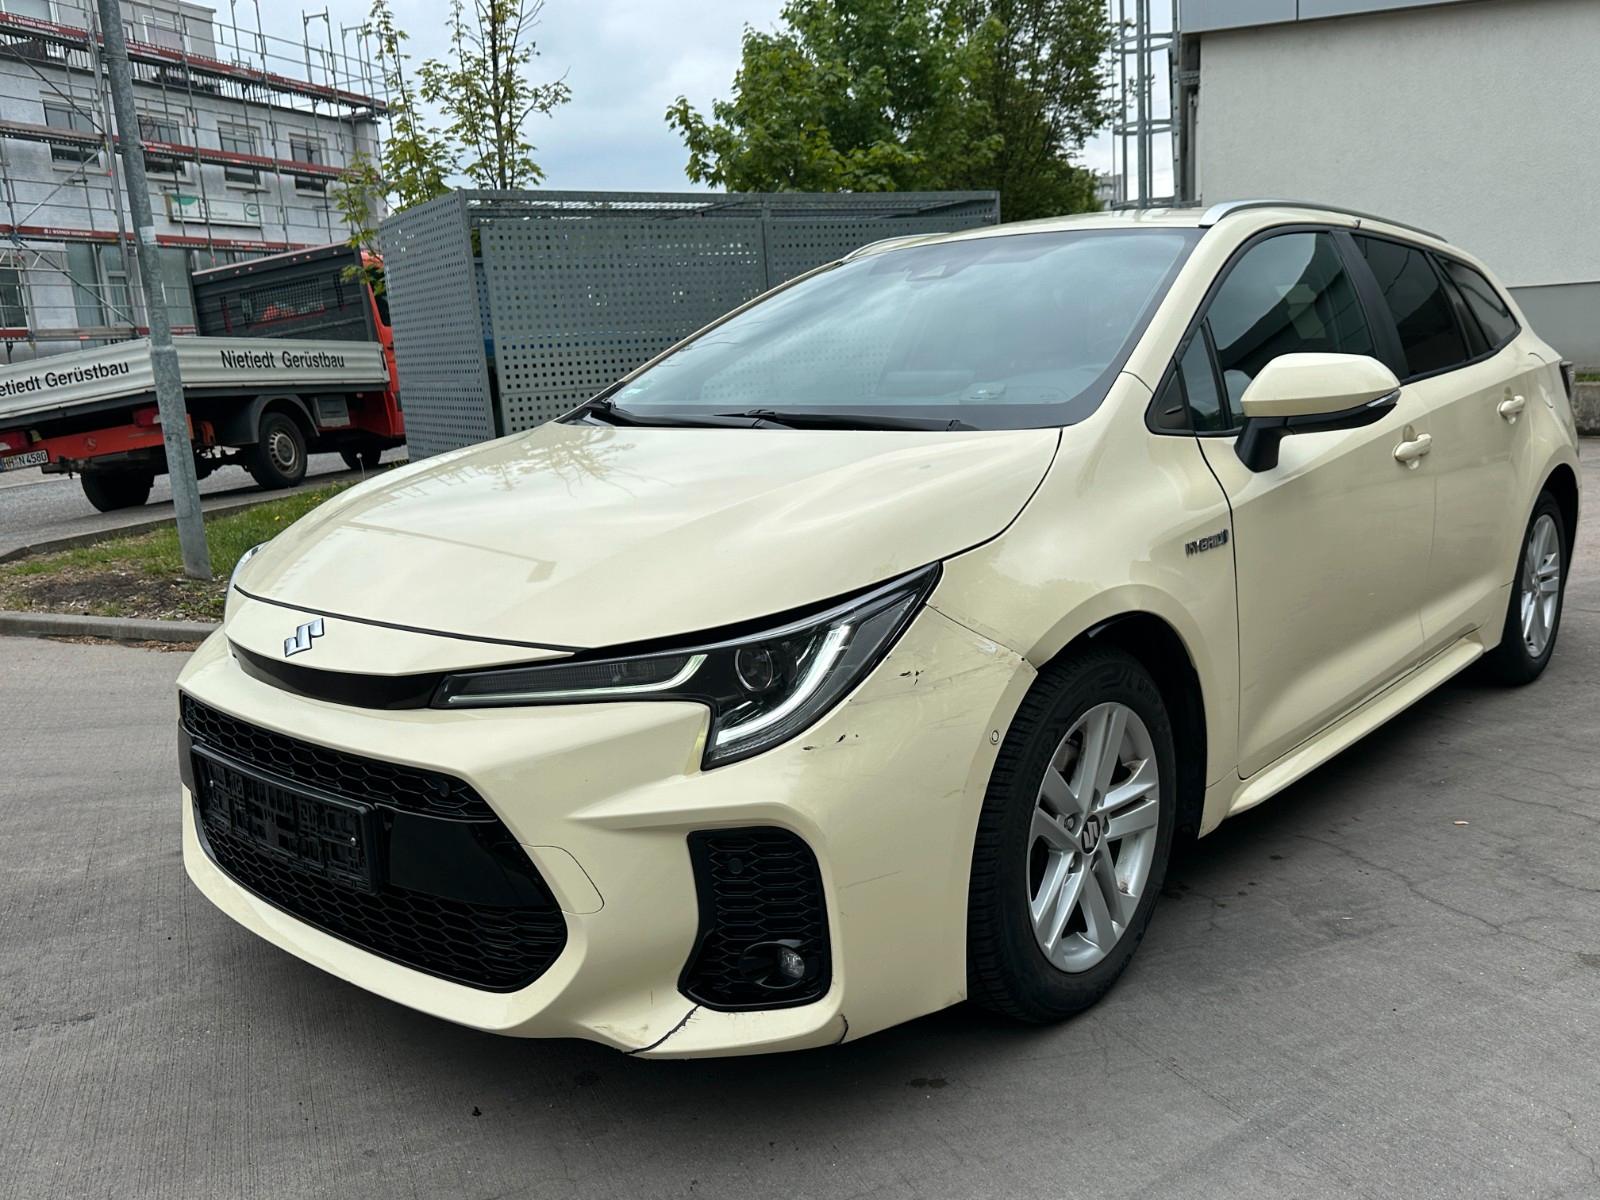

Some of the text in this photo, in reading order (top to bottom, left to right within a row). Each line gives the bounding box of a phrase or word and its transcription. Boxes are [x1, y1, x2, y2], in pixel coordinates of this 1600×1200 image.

[220, 350, 345, 368] Nietiedt Gerüstbau
[45, 361, 130, 388] Gerüstbau
[27, 452, 47, 463] 4580
